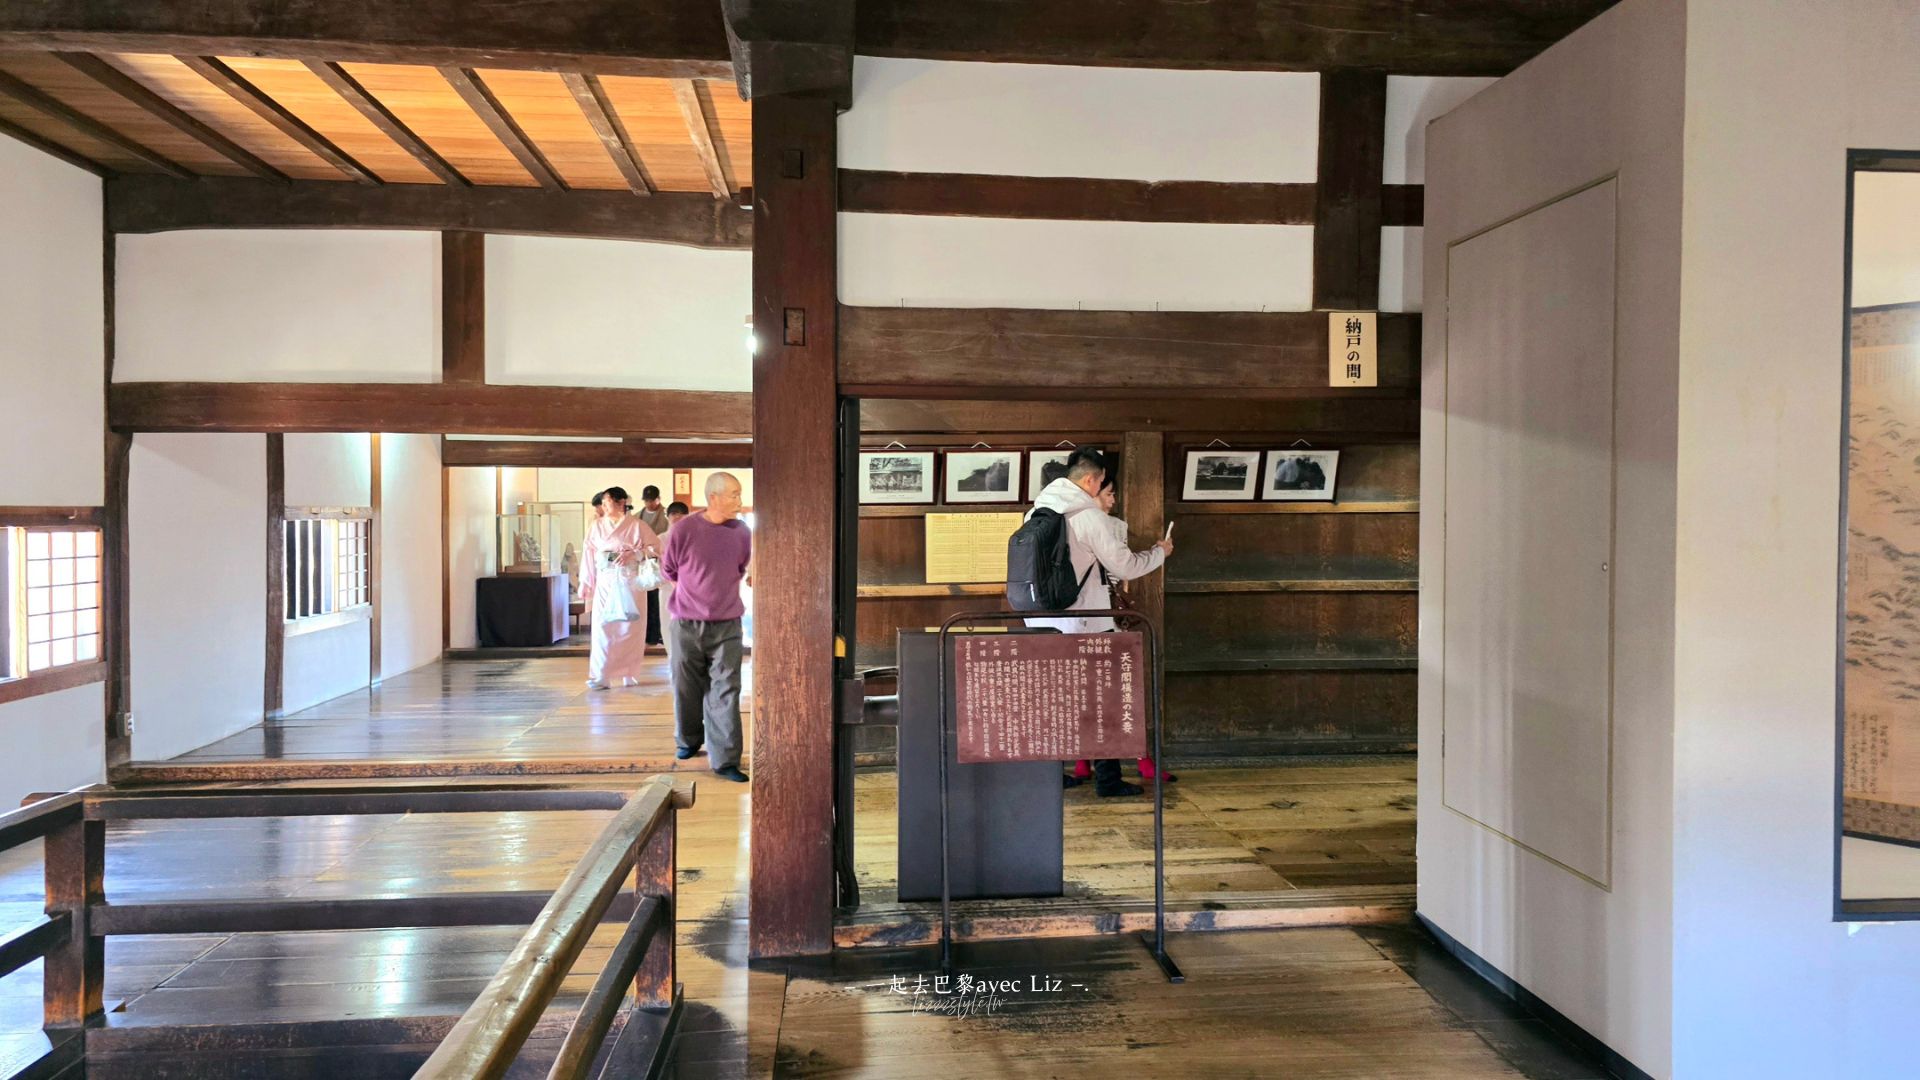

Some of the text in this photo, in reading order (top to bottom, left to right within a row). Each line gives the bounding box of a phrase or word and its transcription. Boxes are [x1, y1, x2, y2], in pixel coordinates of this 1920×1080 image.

[1345, 318, 1362, 379] 納戸の間
[1120, 652, 1134, 734] 天守閣構造の大要
